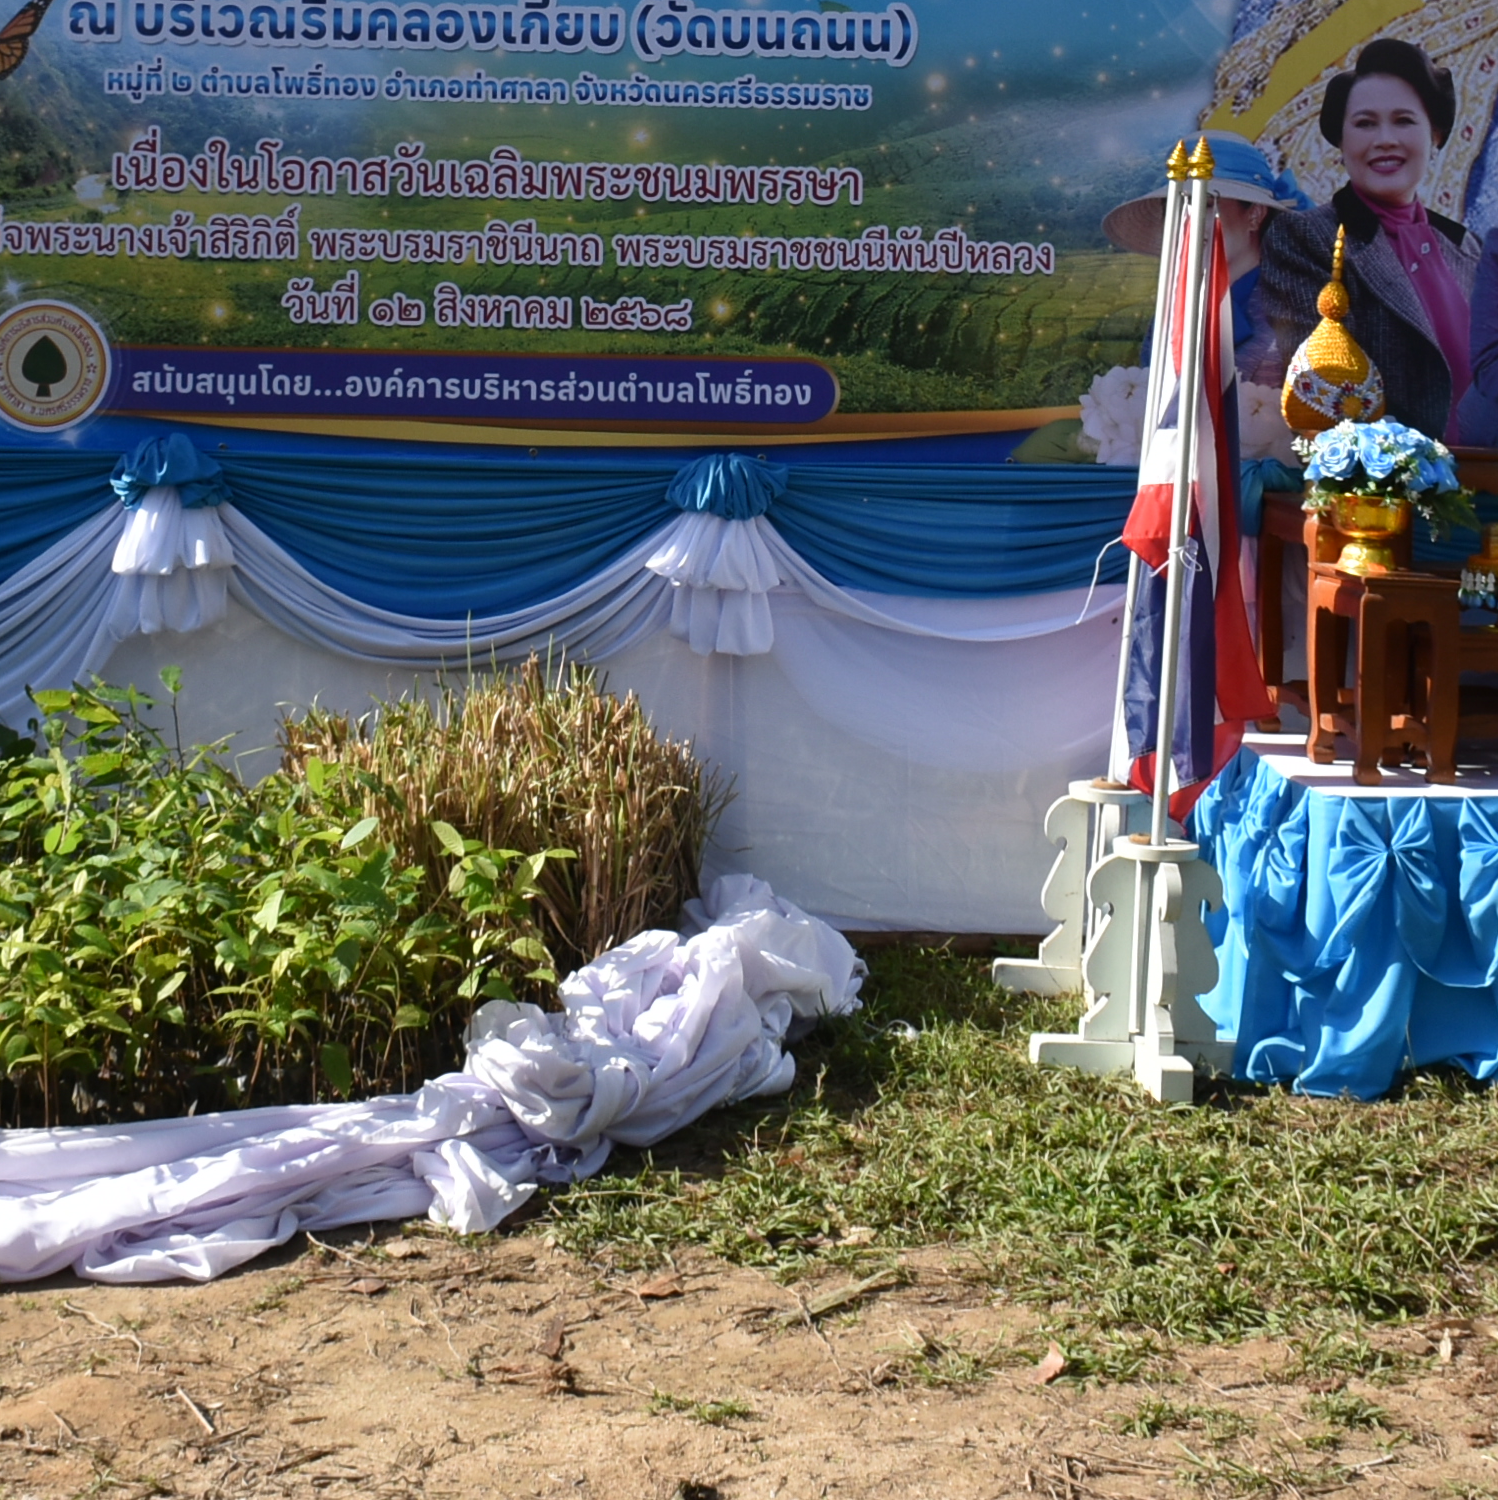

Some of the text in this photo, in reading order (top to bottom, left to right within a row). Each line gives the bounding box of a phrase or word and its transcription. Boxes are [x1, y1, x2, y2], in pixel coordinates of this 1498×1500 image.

[68, 0, 115, 36] ณ
[636, 0, 911, 61] (วัดบนถนน)
[107, 57, 870, 108] หมู่ที่ ๒ ตำบลโพธิ์ทอง อำเภอท่าศาลา จังหวัดนครศรีธรรมราช
[113, 128, 861, 202] เนื่องในโอกาสวันเฉลิมพระชนมพรรษา
[311, 222, 600, 265] พระบรมราชินีนาถ
[616, 228, 1054, 272] พระบรมราชชนนีพันปีหลวง
[284, 273, 691, 329] วันที่ ๑๒ สิงหาคม ๒๕๖๘
